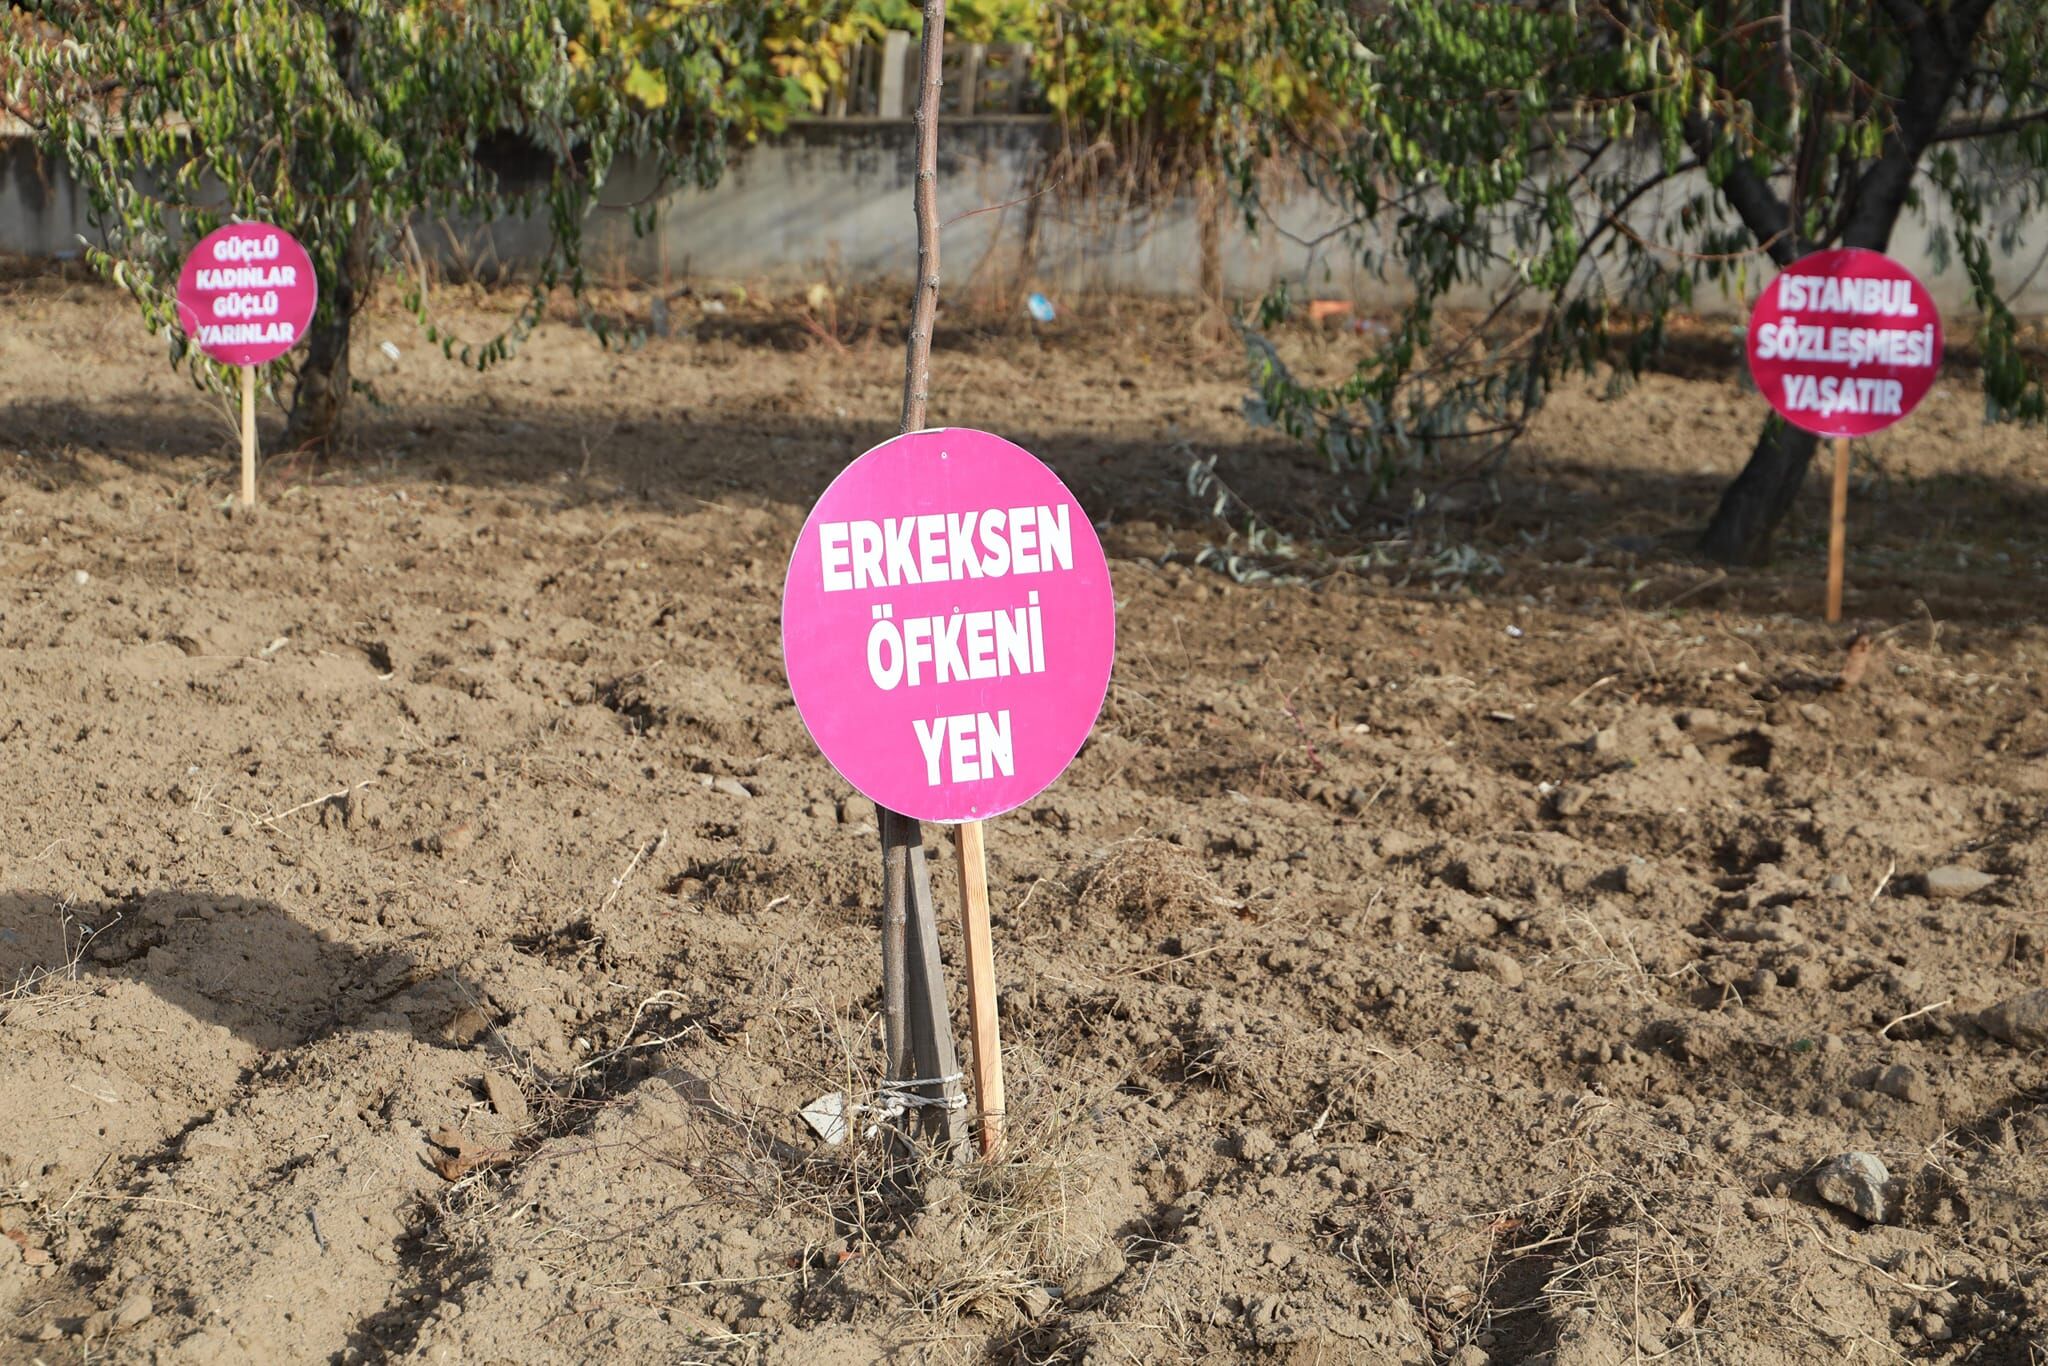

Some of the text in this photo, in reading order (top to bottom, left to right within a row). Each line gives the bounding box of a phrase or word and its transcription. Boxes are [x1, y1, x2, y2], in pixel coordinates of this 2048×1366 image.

[213, 235, 279, 262] GÜÇLÜ
[196, 266, 296, 290] KADINLAR
[1778, 273, 1918, 317] İSTANBUL
[213, 291, 278, 319] GÜÇLÜ
[199, 322, 294, 345] YARINLAR
[1756, 316, 1934, 369] SÖZLEŞMESİ
[1782, 374, 1903, 417] YAŞATIR
[819, 503, 1074, 592] ERKEKSEN
[866, 590, 1046, 691] ÖFKENİ
[912, 709, 1015, 787] YEN
